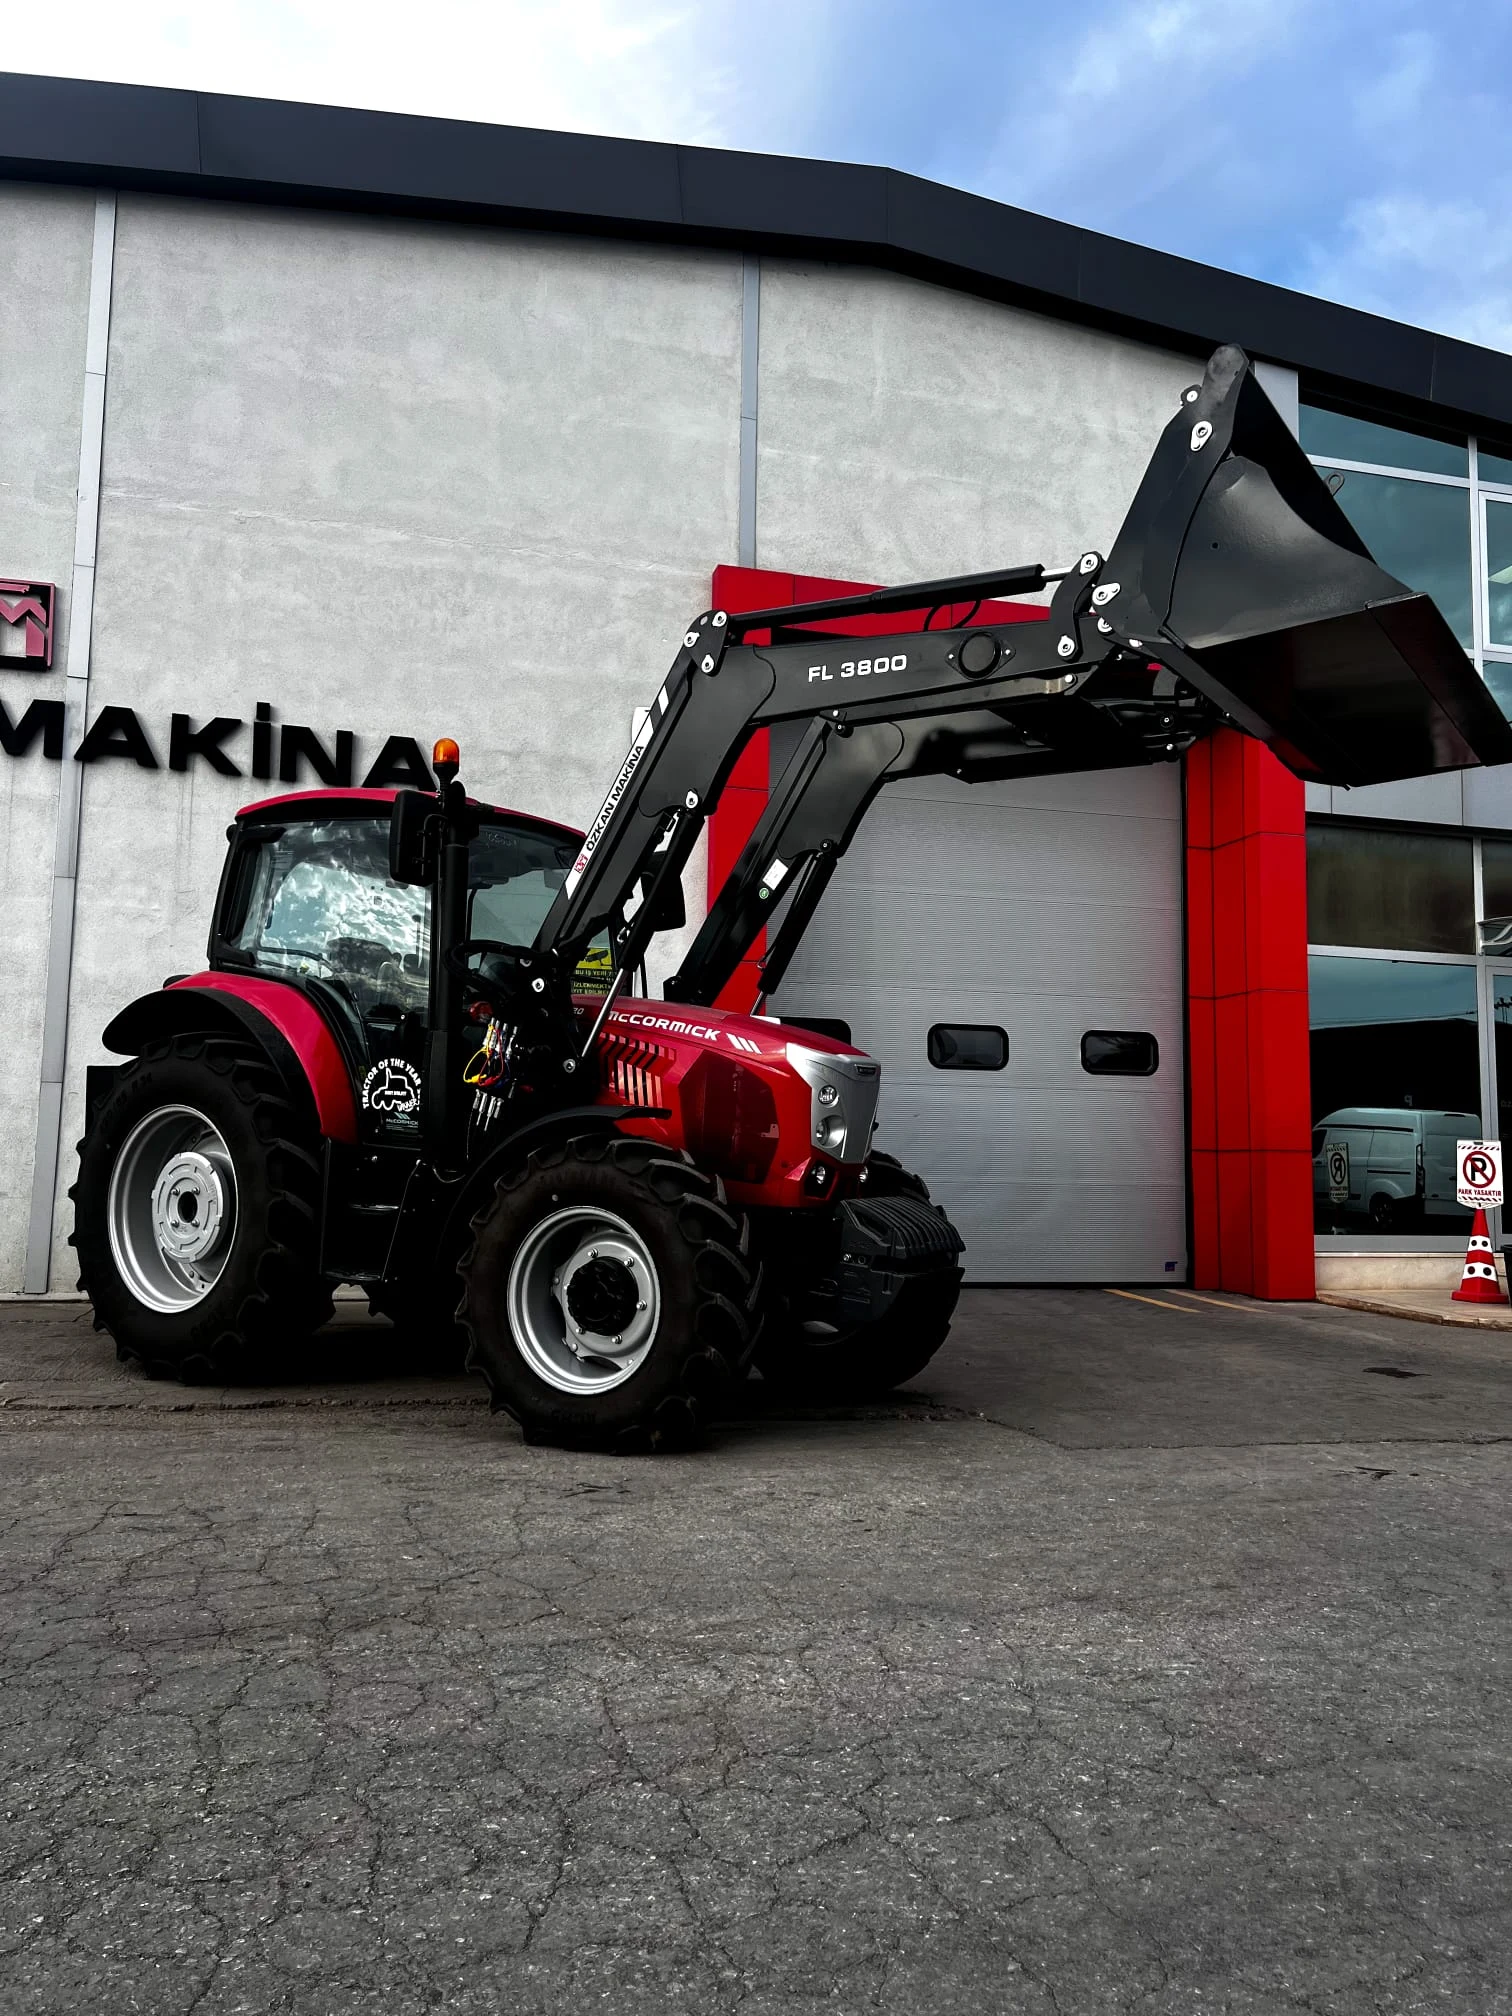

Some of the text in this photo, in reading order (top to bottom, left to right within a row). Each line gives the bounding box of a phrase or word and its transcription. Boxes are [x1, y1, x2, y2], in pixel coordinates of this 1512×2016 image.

[808, 654, 907, 682] FL 3800
[0, 698, 440, 792] MAKİNA
[586, 745, 645, 852] ÖZKAN MAKİNA
[362, 1066, 379, 1109] TRACTOR
[378, 1058, 389, 1069] OF
[390, 1057, 405, 1069] THE
[405, 1063, 422, 1087] YEAR
[1470, 1157, 1488, 1182] P
[1474, 1189, 1502, 1197] YASAKTIR
